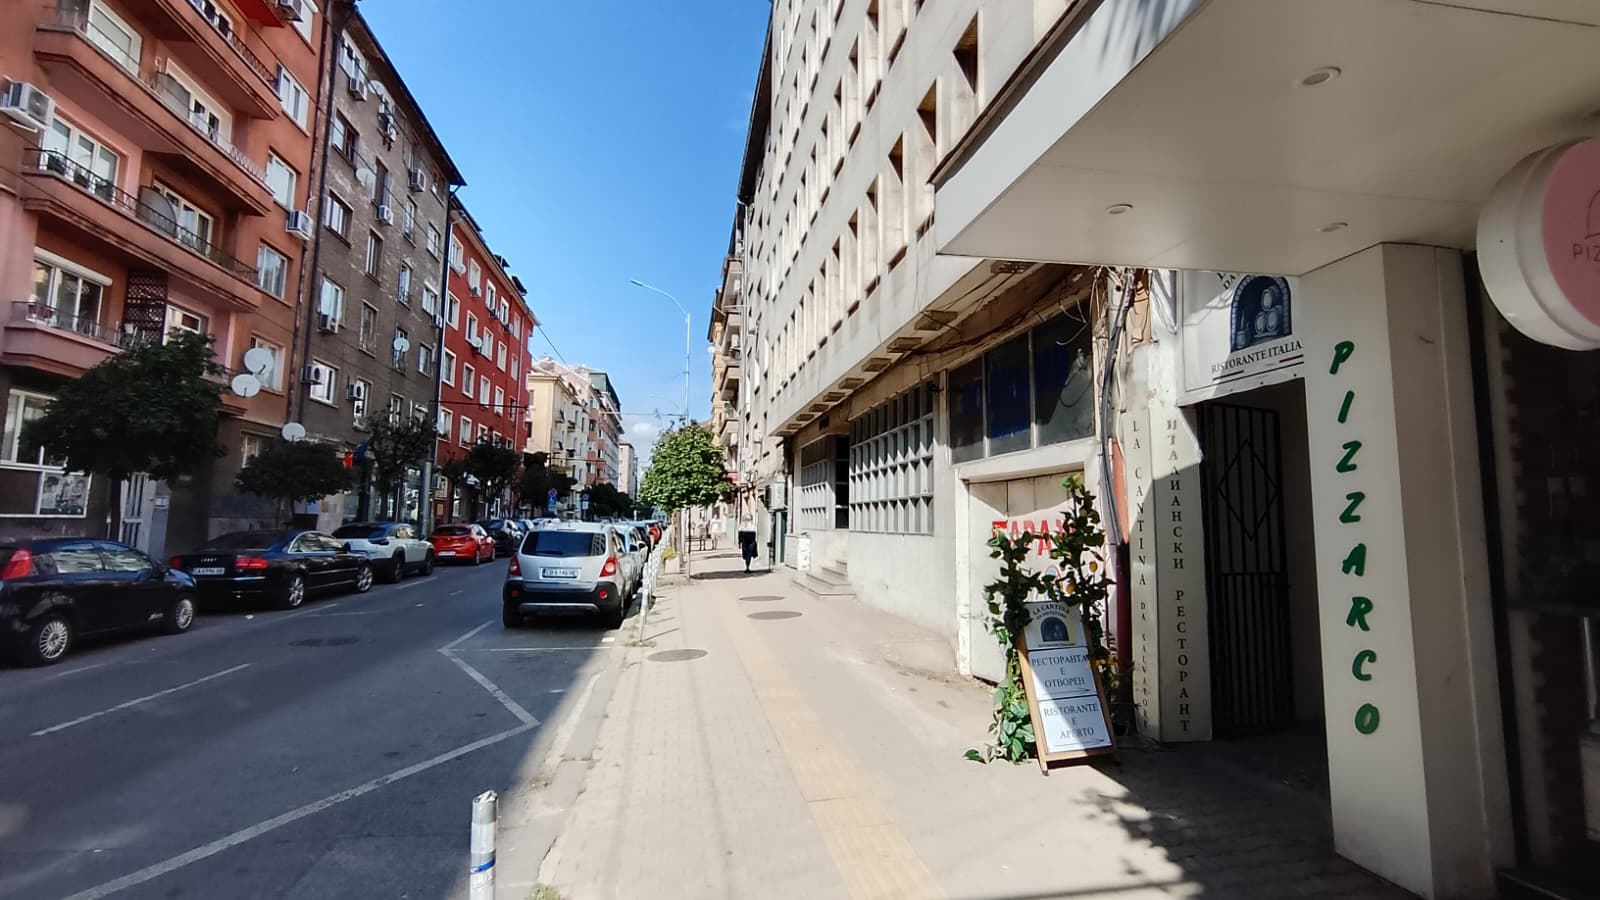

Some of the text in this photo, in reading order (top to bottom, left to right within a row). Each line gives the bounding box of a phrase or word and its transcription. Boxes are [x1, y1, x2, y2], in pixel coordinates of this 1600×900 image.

[1211, 351, 1267, 374] RISTORANTE
[1133, 420, 1141, 450] LA
[1135, 467, 1147, 586] CANTINA
[1329, 340, 1380, 735] PIZZARCO
[1167, 420, 1190, 731] ИТАЛИАНСКИ РЕСТОРАНТ
[1044, 676, 1085, 688] ОТВОРЕН
[1043, 702, 1099, 718] RISTORANTE
